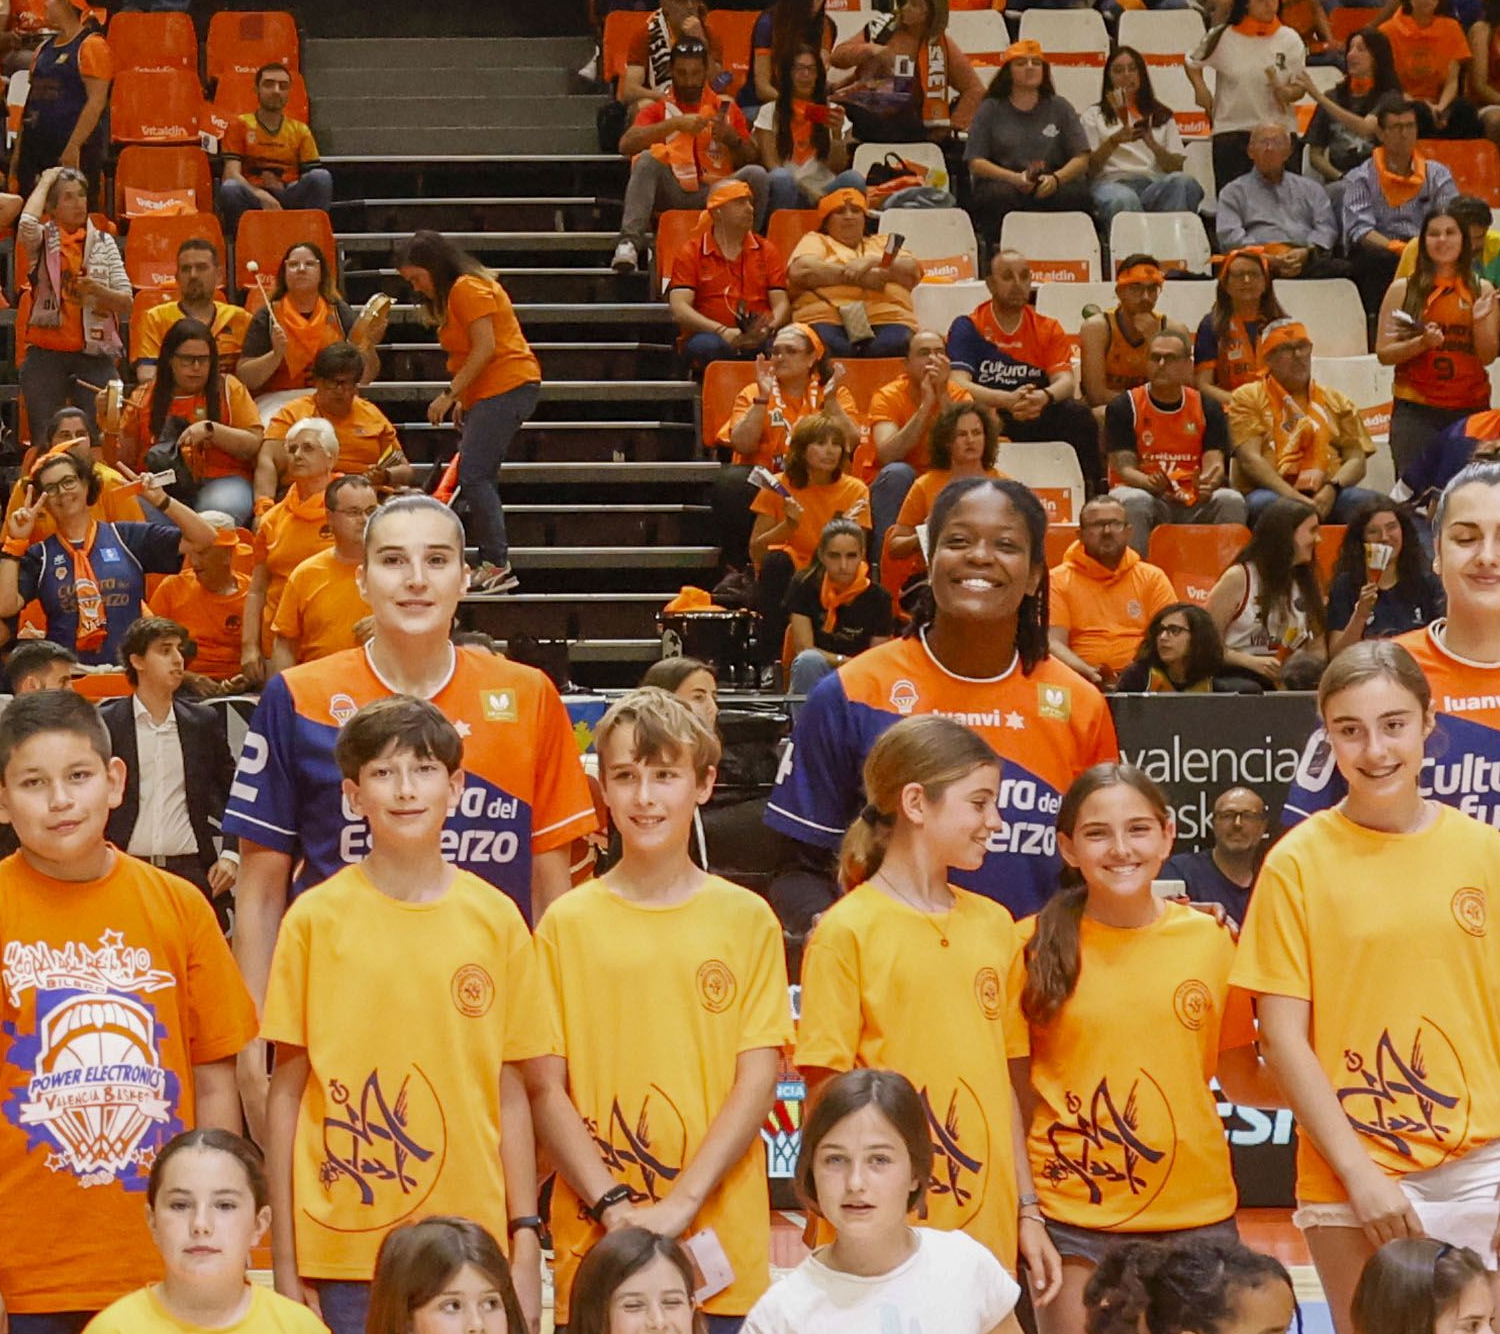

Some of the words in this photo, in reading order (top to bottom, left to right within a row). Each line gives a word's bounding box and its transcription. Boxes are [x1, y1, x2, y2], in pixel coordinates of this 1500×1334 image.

[927, 43, 949, 99] SKET
[979, 359, 1027, 376] Cultura
[1433, 355, 1454, 380] 9
[1120, 735, 1299, 783] valencia
[492, 797, 518, 819] del
[1039, 792, 1062, 813] del
[339, 829, 518, 863] Eserzo
[986, 820, 1057, 856] erzo
[30, 1068, 83, 1092] POWER
[86, 1065, 162, 1087] ELECTRONICS
[44, 1088, 102, 1108] VALENCIA
[105, 1086, 151, 1105] BASKET
